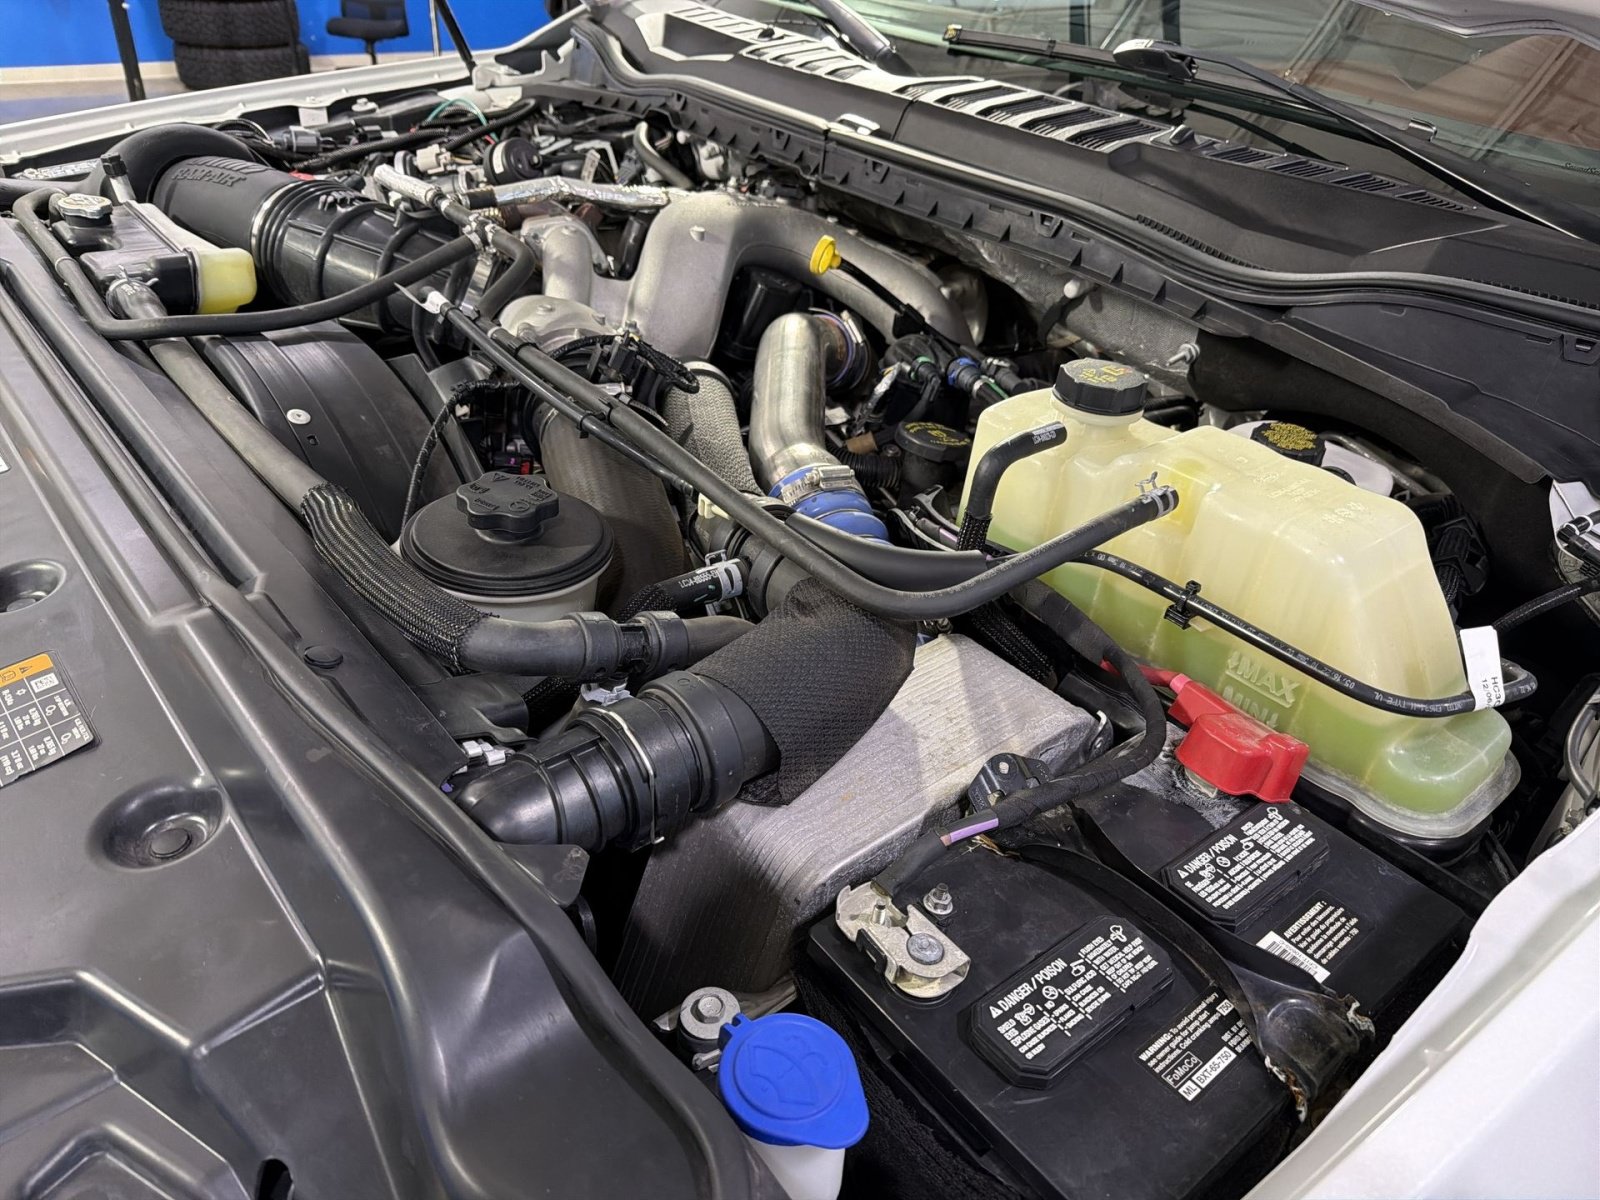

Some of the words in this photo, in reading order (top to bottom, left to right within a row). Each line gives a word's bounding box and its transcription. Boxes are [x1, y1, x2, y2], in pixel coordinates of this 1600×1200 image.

[1236, 655, 1300, 703] MAX
[1183, 852, 1213, 873] DANGER
[1211, 834, 1237, 854] POISON
[1284, 902, 1324, 938] AVERTISSEMENT
[997, 983, 1034, 1011] DANGER
[1034, 958, 1067, 984] POISON
[1139, 1033, 1173, 1061] WARNING:
[1177, 1016, 1190, 1030] avoid
[1187, 1001, 1207, 1021] personal
[1204, 992, 1219, 1004] injury
[1169, 1035, 1183, 1048] guide
[1180, 1029, 1189, 1037] for
[1198, 1011, 1210, 1022] start
[1179, 1037, 1192, 1049] Cold
[1190, 1022, 1211, 1040] cranking
[1219, 1001, 1232, 1015] 750
[1167, 1056, 1198, 1085] FoMoCo
[1196, 1050, 1232, 1084] BXT-65-750
[1183, 1085, 1197, 1098] ML
